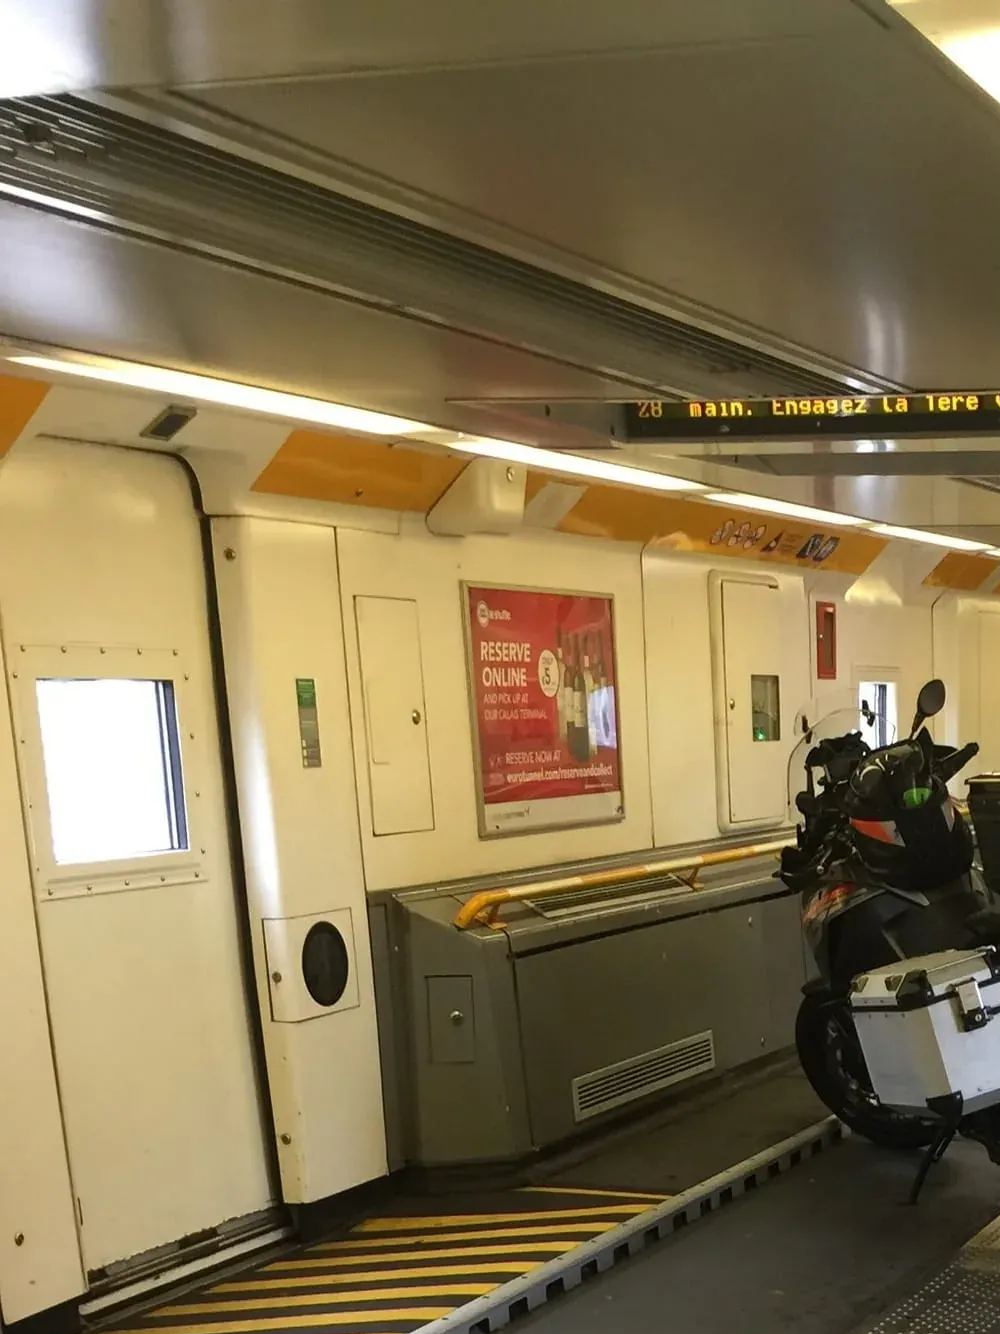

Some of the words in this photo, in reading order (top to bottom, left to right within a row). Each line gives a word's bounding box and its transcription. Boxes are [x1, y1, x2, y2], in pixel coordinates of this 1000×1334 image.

[689, 400, 753, 418] main.
[772, 397, 867, 416] Engagez
[883, 395, 909, 413] la
[480, 641, 531, 662] RESERVE
[482, 666, 528, 687] ONLINE
[484, 693, 498, 704] AND
[498, 693, 511, 704] PICK
[512, 693, 521, 704] UP
[521, 693, 529, 704] AT
[484, 709, 498, 720] OUR
[499, 708, 519, 720] CALAIS
[519, 708, 547, 719] TERMINAL
[505, 752, 535, 765] RESERVE
[535, 750, 552, 763] NOW
[552, 749, 562, 762] AT
[506, 762, 613, 784] eurotunnel.com/reserveandcollect
